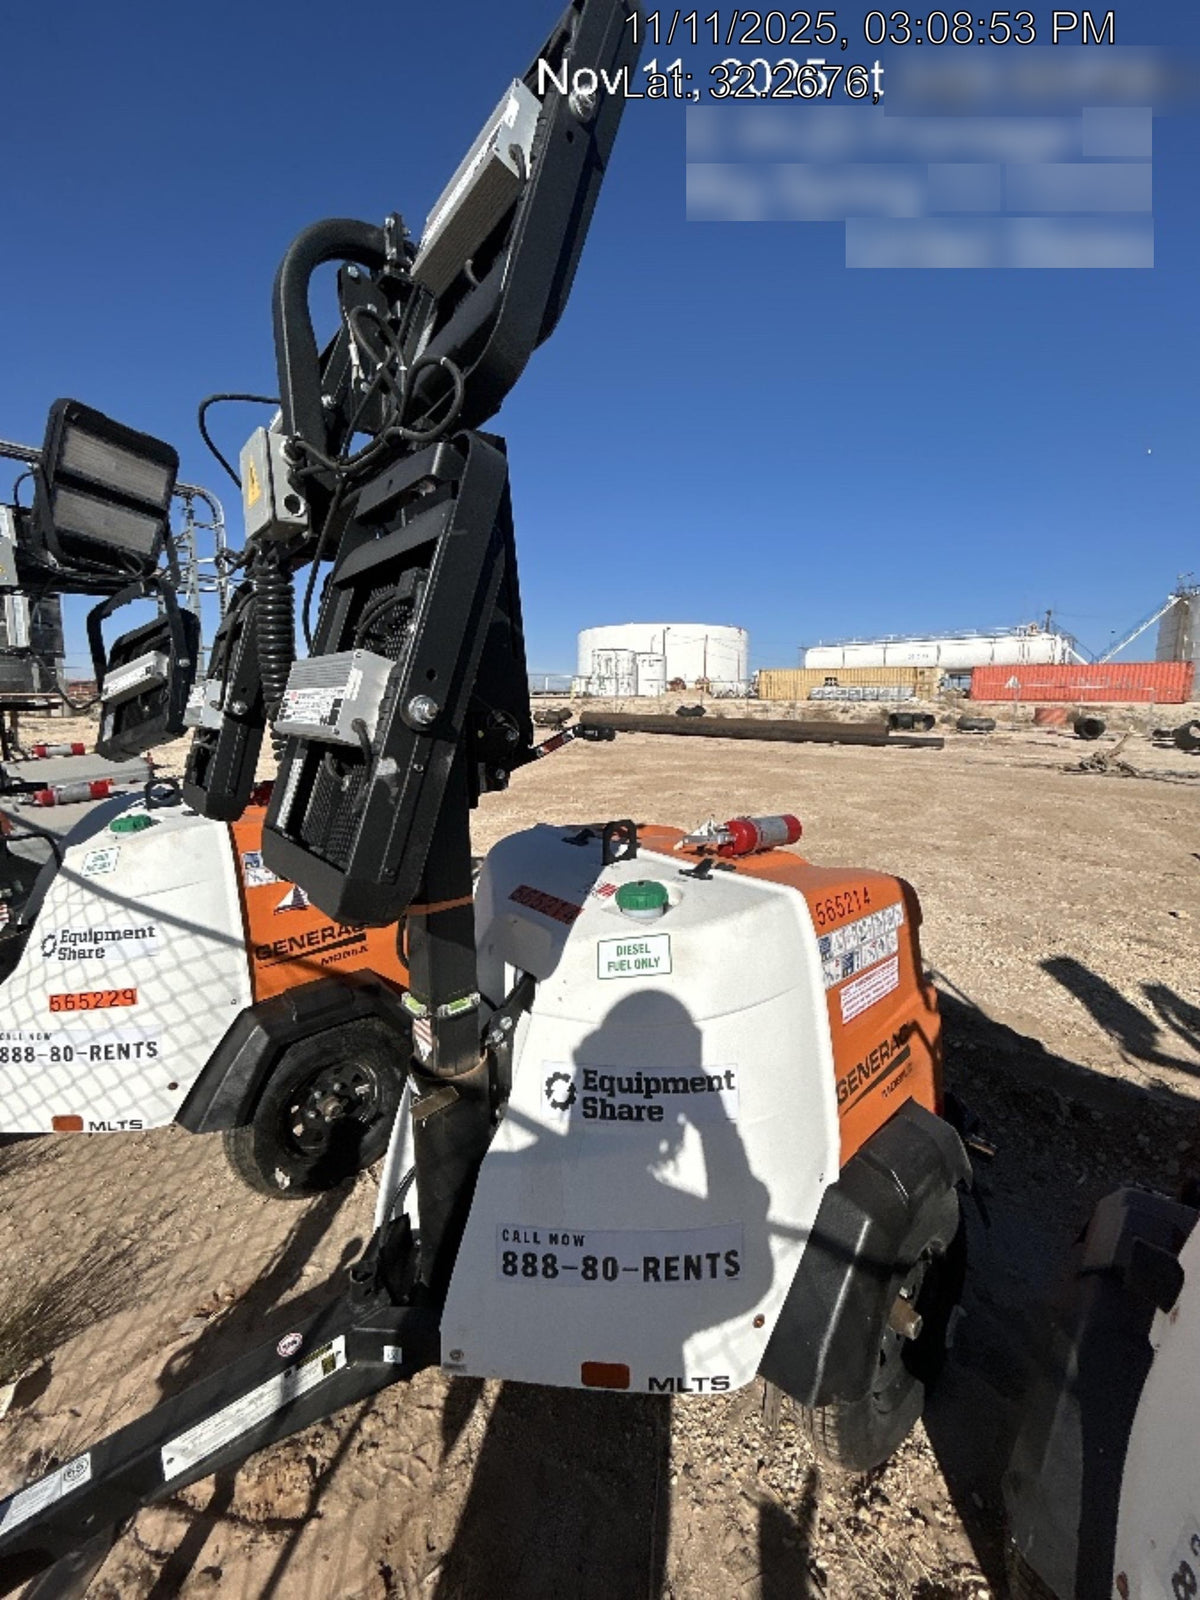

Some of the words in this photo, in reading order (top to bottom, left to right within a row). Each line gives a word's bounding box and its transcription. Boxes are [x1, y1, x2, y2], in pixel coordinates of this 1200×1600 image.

[815, 887, 871, 926] 565214
[60, 925, 156, 946] Equipment
[58, 946, 106, 961] Share
[616, 943, 652, 957] DIESEL
[634, 955, 661, 970] ONLY
[51, 989, 137, 1012] 565229
[0, 1041, 158, 1064] 888-80-RENTS
[582, 1068, 735, 1099] Equipment
[582, 1096, 664, 1122] Share
[89, 1119, 143, 1132] MLTS
[502, 1229, 541, 1244] CALL
[549, 1233, 586, 1247] NOW
[502, 1250, 741, 1282] 888-80-RENTS
[649, 1376, 730, 1393] MLTS
